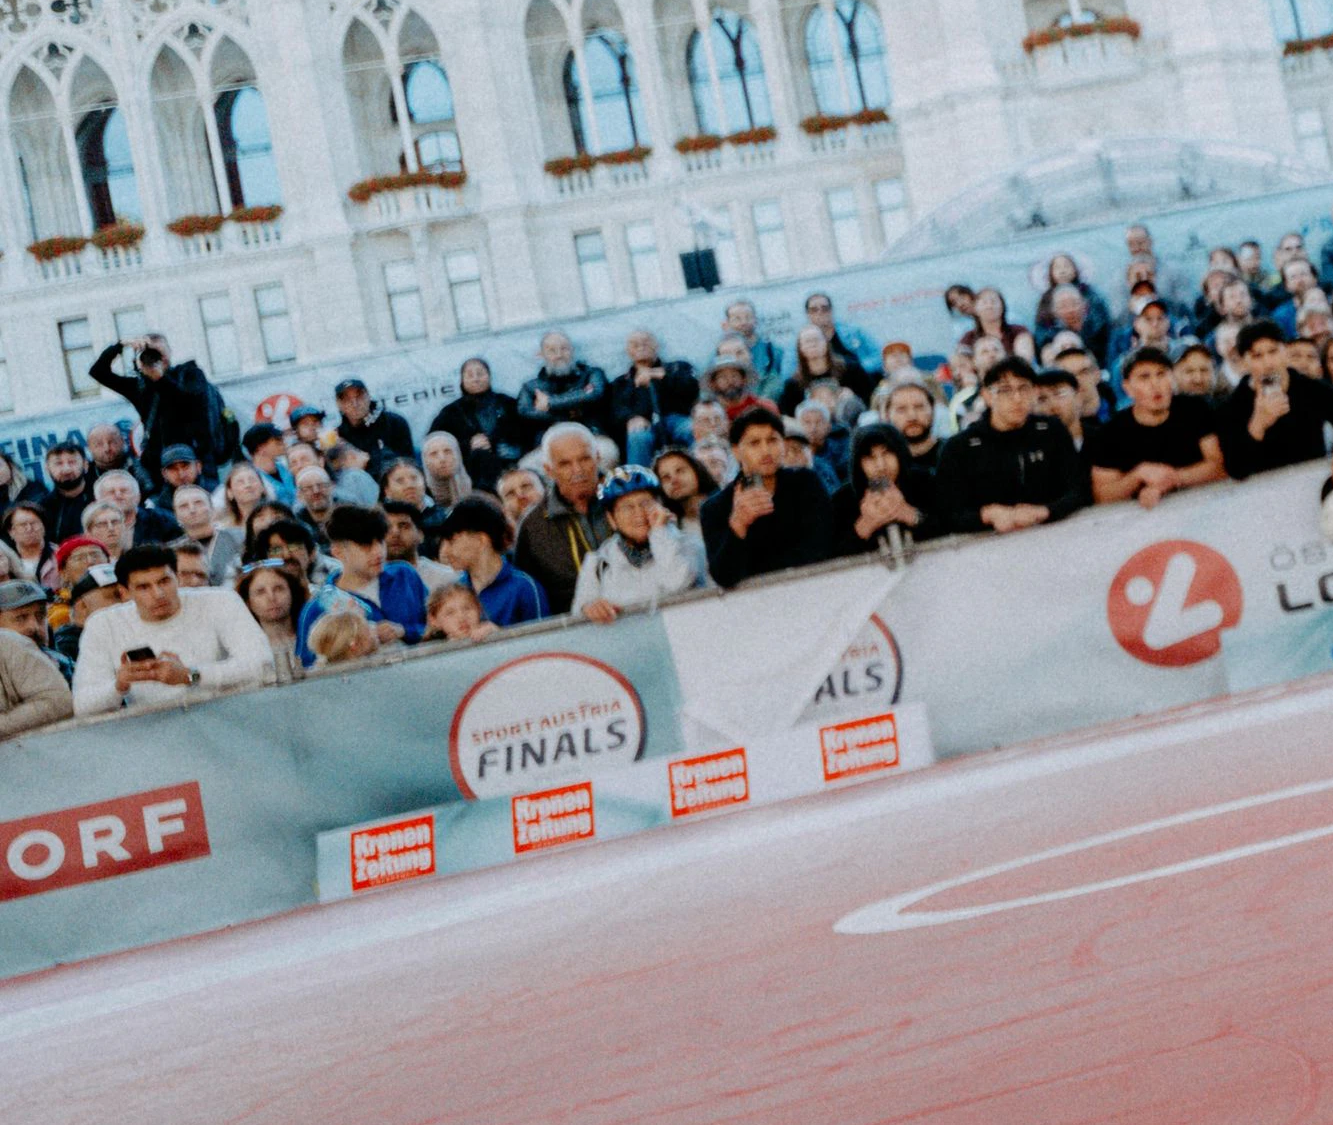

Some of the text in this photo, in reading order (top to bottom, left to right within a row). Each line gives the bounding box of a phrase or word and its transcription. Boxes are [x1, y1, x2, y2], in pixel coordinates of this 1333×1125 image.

[814, 662, 883, 704] ALS
[472, 699, 622, 745] SPORT AUSTRIA
[478, 719, 627, 778] FINALS
[7, 798, 188, 880] ORF
